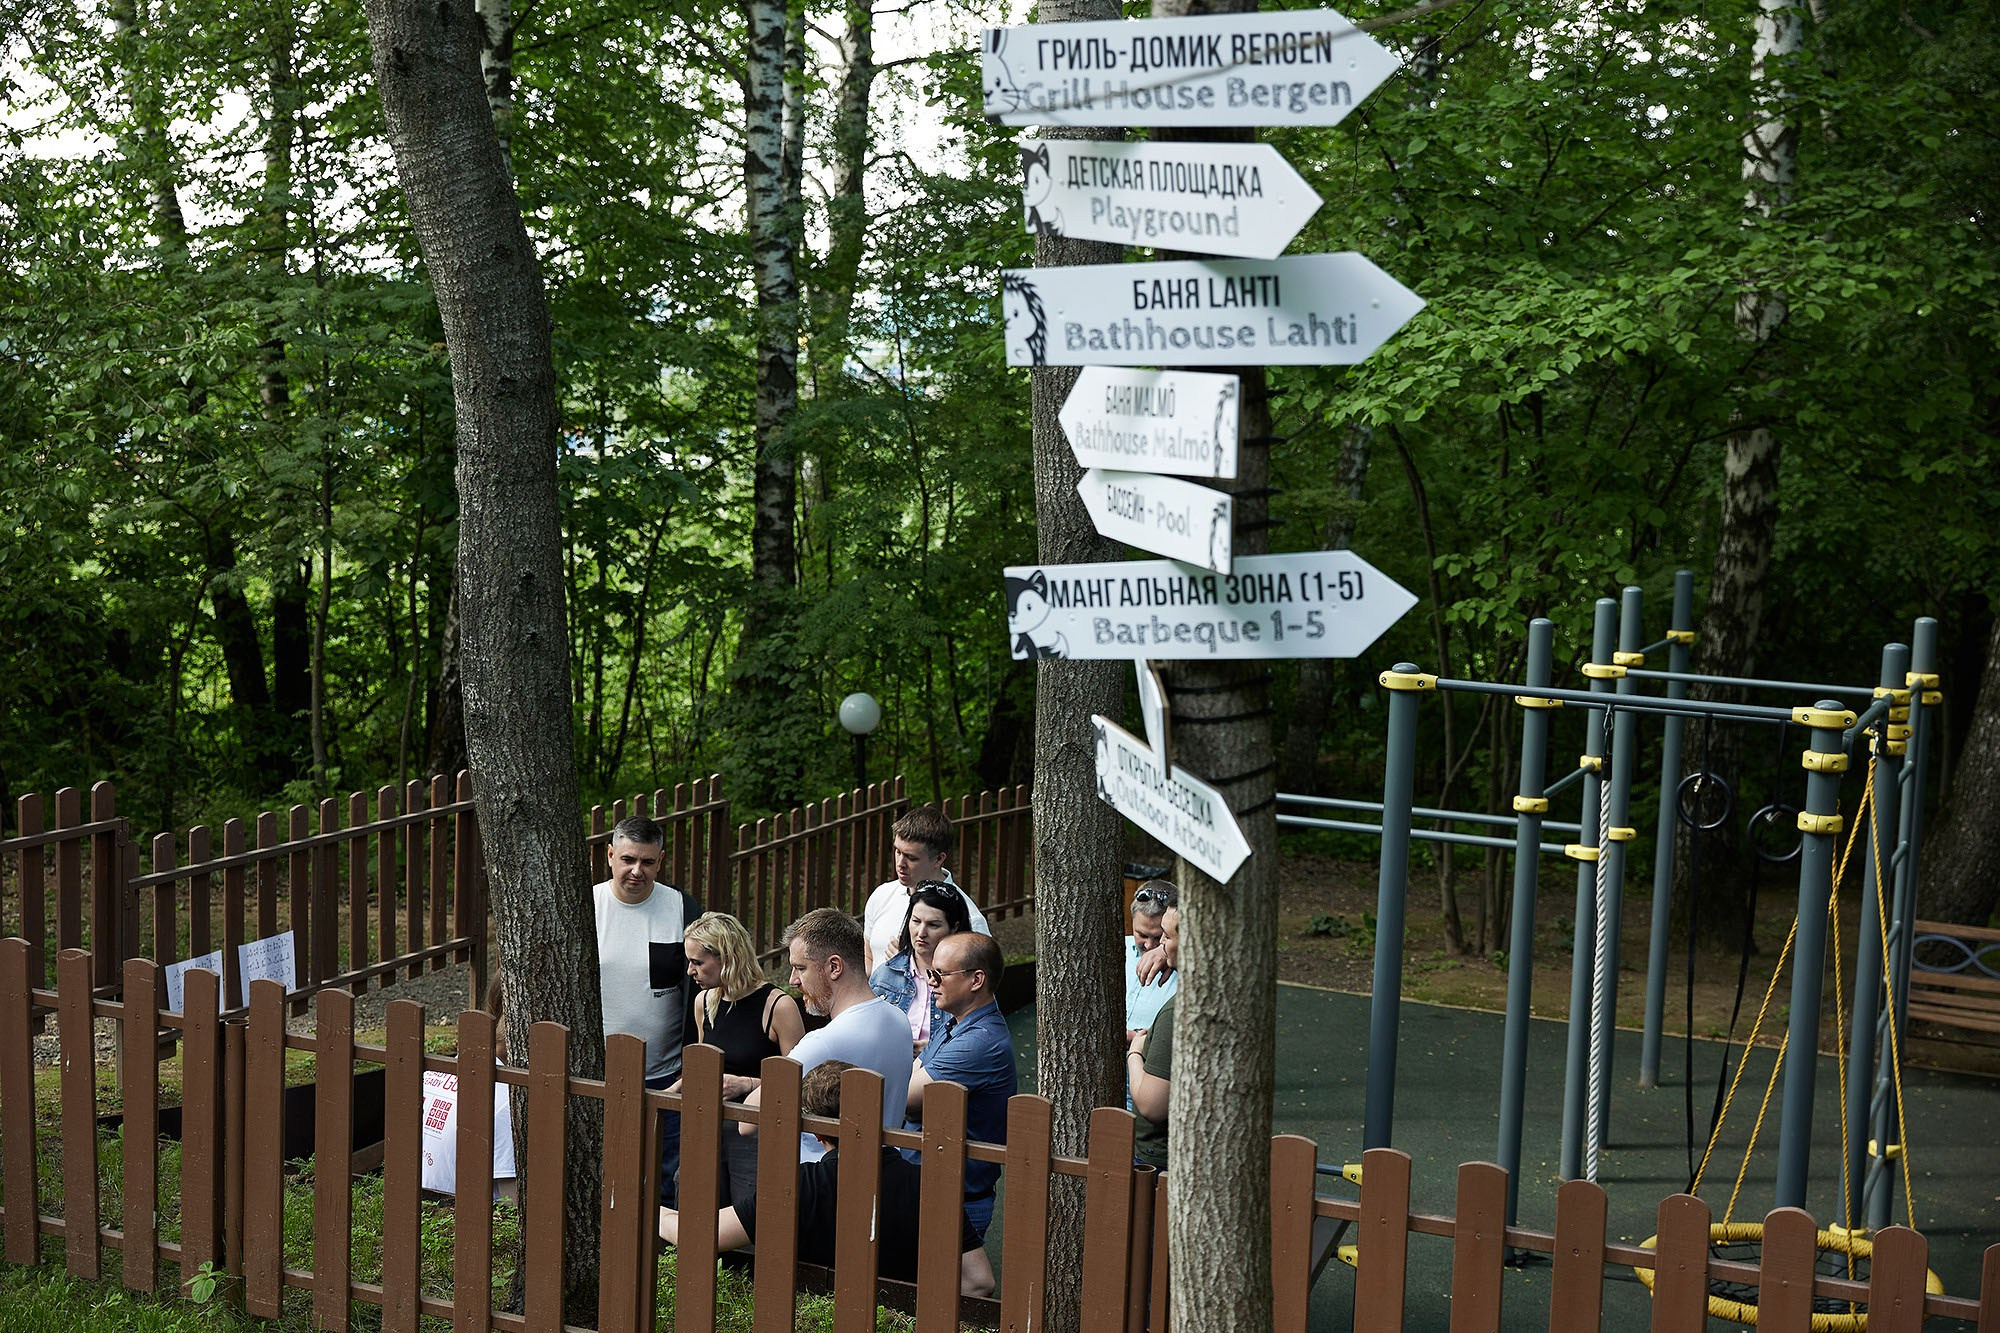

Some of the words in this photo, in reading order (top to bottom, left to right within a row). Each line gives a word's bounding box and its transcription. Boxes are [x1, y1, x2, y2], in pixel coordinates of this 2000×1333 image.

[1038, 34, 1223, 72] ГРИЛЬ-ДОМИК
[1232, 31, 1332, 66] BERGEN
[1025, 77, 1093, 112] Grill
[1105, 78, 1215, 111] House
[1227, 77, 1352, 113] Bergen
[1068, 155, 1143, 191] ДЕТСКАЯ
[1149, 161, 1263, 199] ПЛОЩАДКА
[1090, 197, 1240, 240] Playground
[1133, 277, 1200, 310] БАНЯ
[1209, 275, 1280, 308] LAHTI
[1064, 317, 1256, 352] Bathhouse
[1268, 313, 1358, 347] Lahti
[1106, 385, 1132, 415] БАНЯ
[1075, 420, 1149, 456] Bathhouse
[1157, 501, 1191, 537] Pool
[1051, 574, 1217, 609] МАНГАЛЬНАЯ
[1226, 572, 1292, 605] ЗОНА
[1301, 570, 1365, 603] (1-5)
[1093, 614, 1261, 654] Barbeque
[1271, 610, 1326, 642] 1-5
